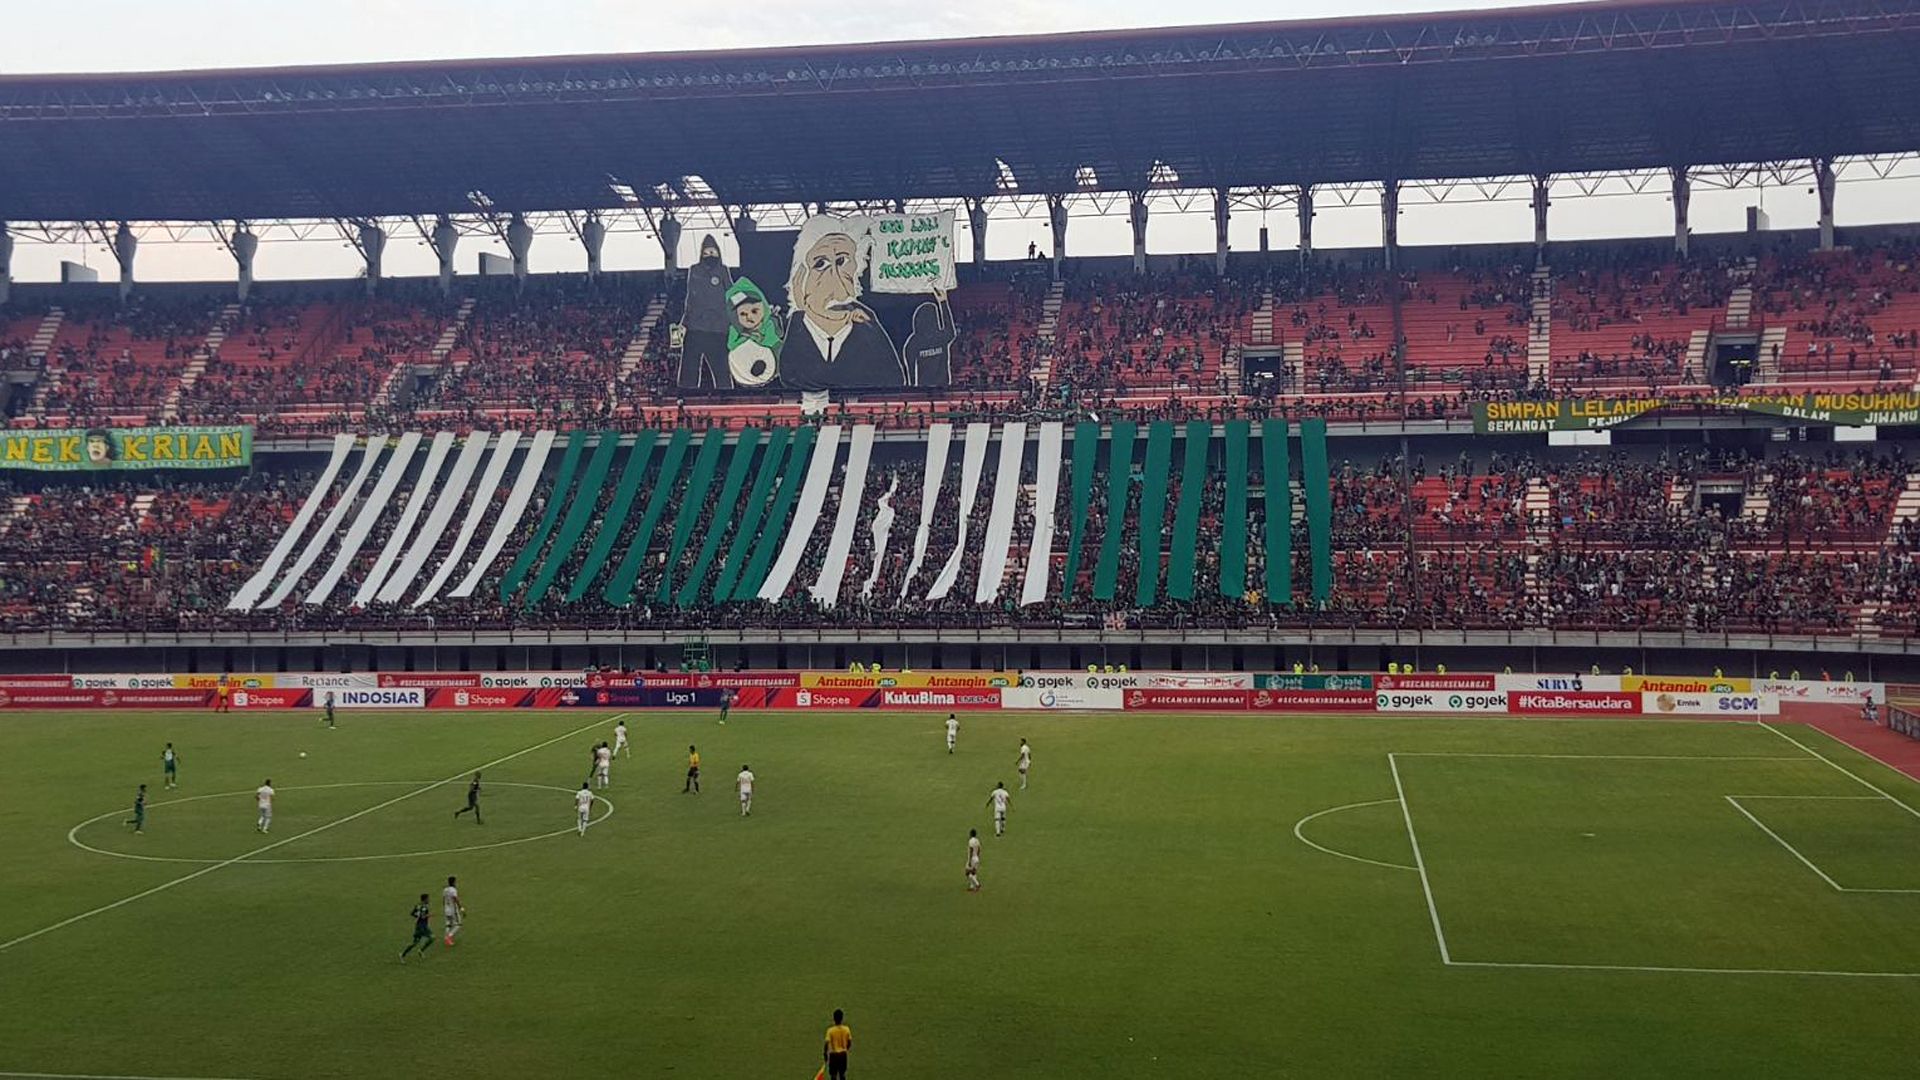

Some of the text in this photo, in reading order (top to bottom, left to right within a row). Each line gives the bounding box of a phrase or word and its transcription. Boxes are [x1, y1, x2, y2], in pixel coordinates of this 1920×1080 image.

[1486, 401, 1560, 419] SIMPAN
[1815, 391, 1920, 410] MUSUHMU
[1487, 419, 1556, 432] SEMANGAT
[1782, 406, 1830, 421] DALAM
[1864, 410, 1919, 423] JIWAMU
[0, 431, 243, 463] NEK KRIAN
[85, 679, 117, 688] gojek
[141, 678, 173, 688] gojek
[189, 677, 241, 688] Antain
[302, 676, 350, 687] Reliance
[495, 677, 528, 689] gojek
[554, 677, 587, 689] gojek
[816, 676, 875, 688] Antangin
[927, 676, 986, 688] Antangin
[1037, 676, 1073, 689] gojek
[1102, 676, 1138, 690] gojek
[1537, 679, 1580, 690] SURY
[1639, 681, 1708, 693] Antangin
[249, 694, 284, 706] Shopee
[342, 691, 419, 704] INDOSIAR
[470, 694, 506, 706] Shopee
[666, 691, 688, 705] Liga
[812, 693, 850, 706] Shopee
[884, 690, 955, 705] KukuBima
[1392, 694, 1433, 708] gojek
[1466, 695, 1507, 709] gojek
[1519, 695, 1632, 709] #KitaBersaudara
[1718, 697, 1758, 710] SCM
